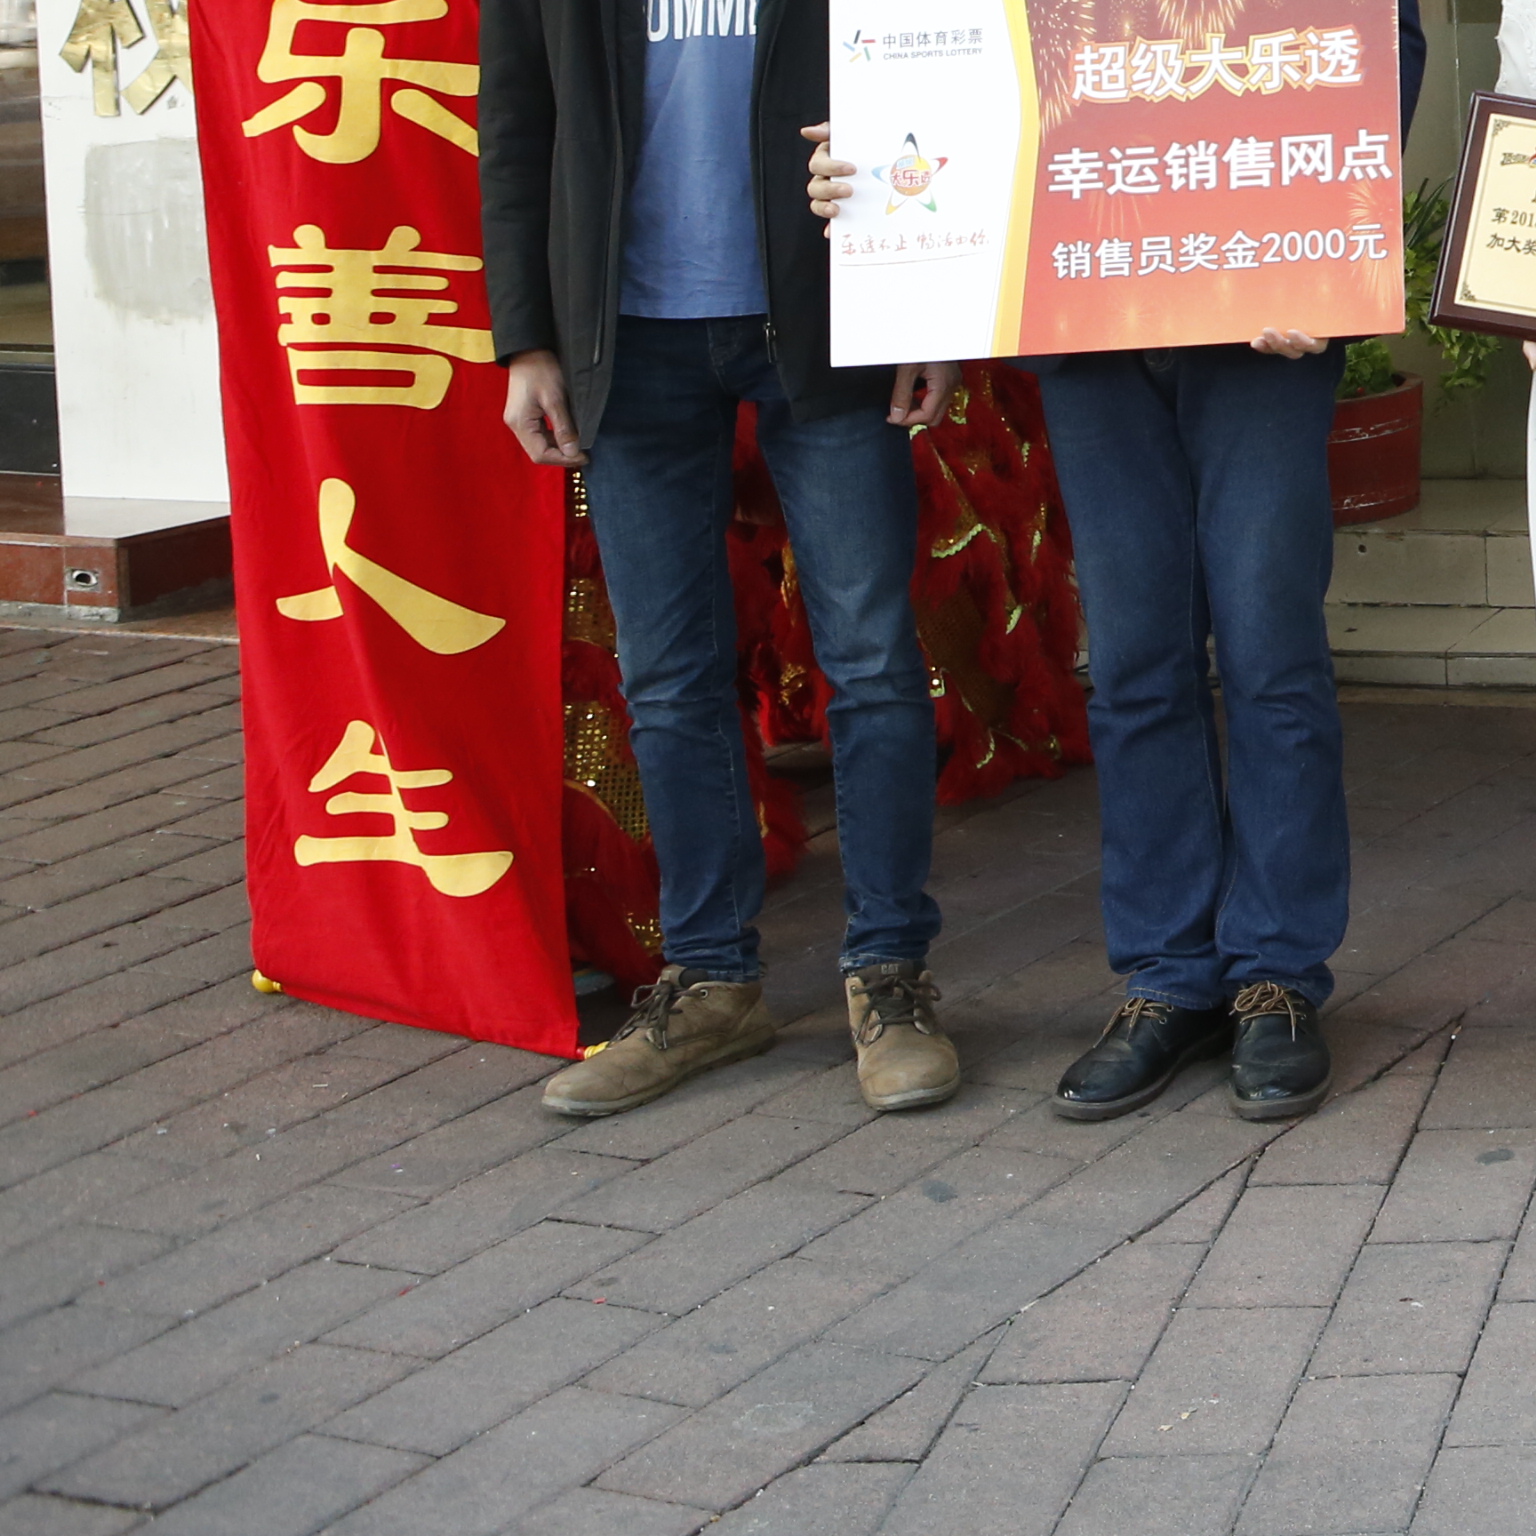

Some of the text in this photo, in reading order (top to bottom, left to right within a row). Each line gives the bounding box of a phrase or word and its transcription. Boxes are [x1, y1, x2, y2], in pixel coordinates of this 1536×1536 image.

[882, 28, 983, 50] 中国体育彩票
[883, 47, 983, 60] CHINA SPORTS LOTTERY
[1071, 28, 1363, 101] 超级大乐透
[1047, 129, 1393, 200] 幸运销售网点
[1052, 223, 1388, 279] 销售员奖金2000元
